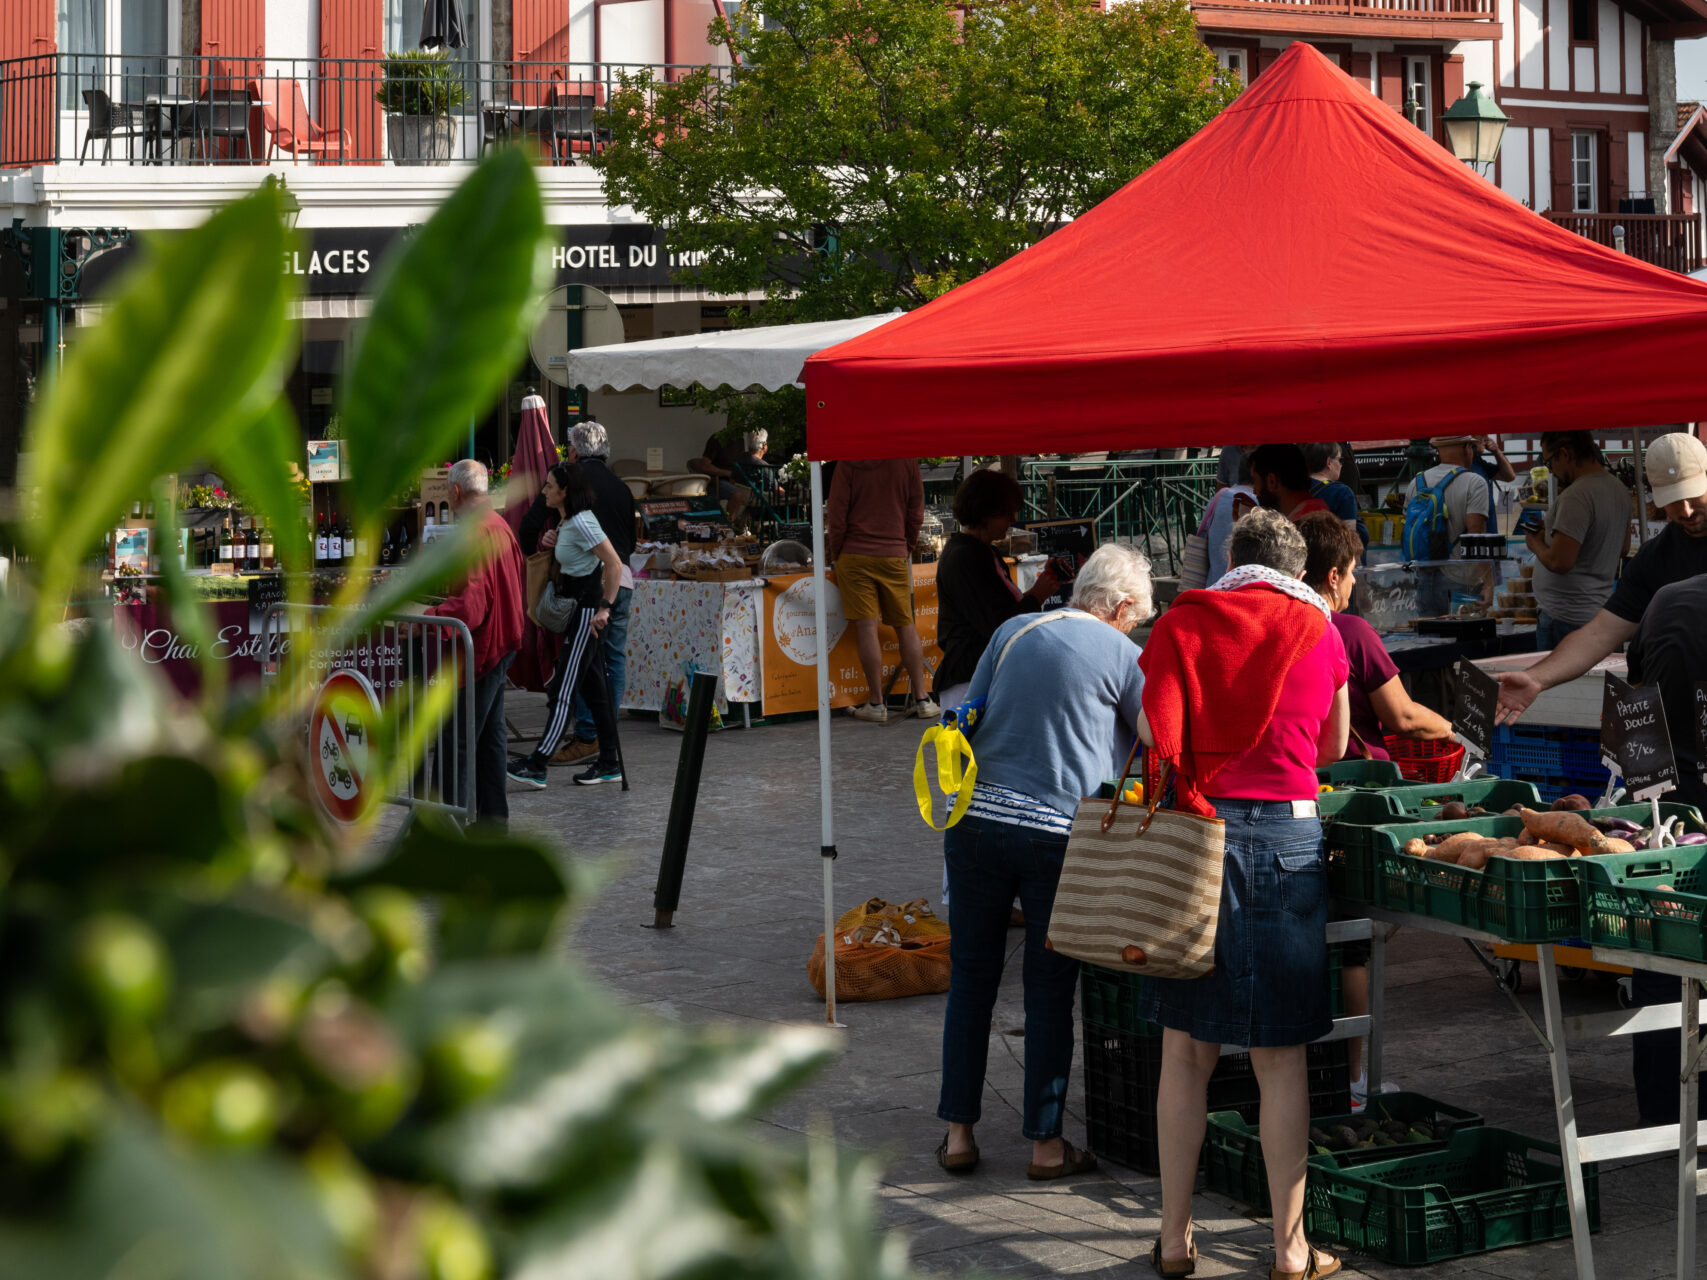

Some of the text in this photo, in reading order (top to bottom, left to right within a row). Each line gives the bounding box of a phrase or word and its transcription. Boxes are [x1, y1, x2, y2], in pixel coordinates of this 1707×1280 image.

[552, 245, 621, 269] HOTEL
[628, 244, 657, 268] DU
[140, 628, 200, 664] Chai
[1616, 700, 1650, 717] PATATE
[1624, 714, 1656, 731] DOUCE
